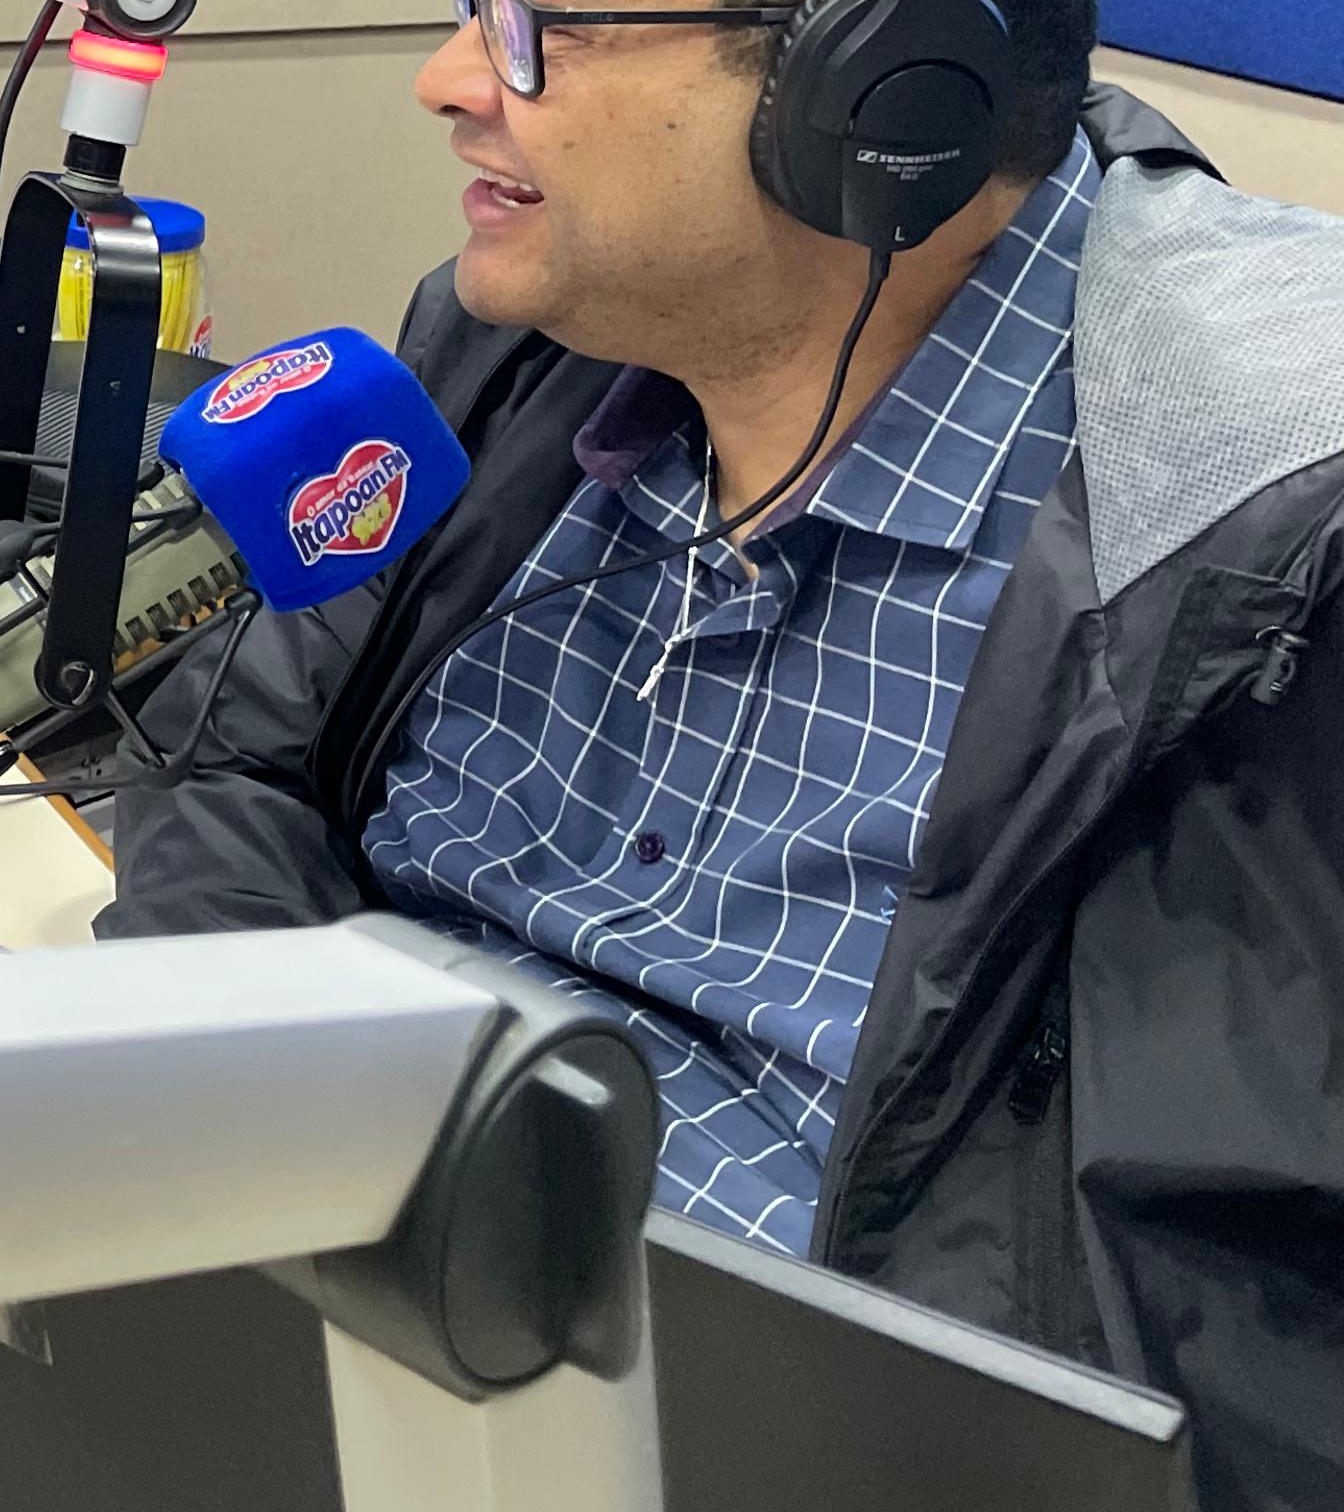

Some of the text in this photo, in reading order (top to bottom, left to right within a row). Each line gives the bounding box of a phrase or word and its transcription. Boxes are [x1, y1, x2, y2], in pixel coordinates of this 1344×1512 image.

[894, 225, 906, 242] L
[228, 344, 330, 402] Itapoan
[292, 468, 387, 562] Itapoan
